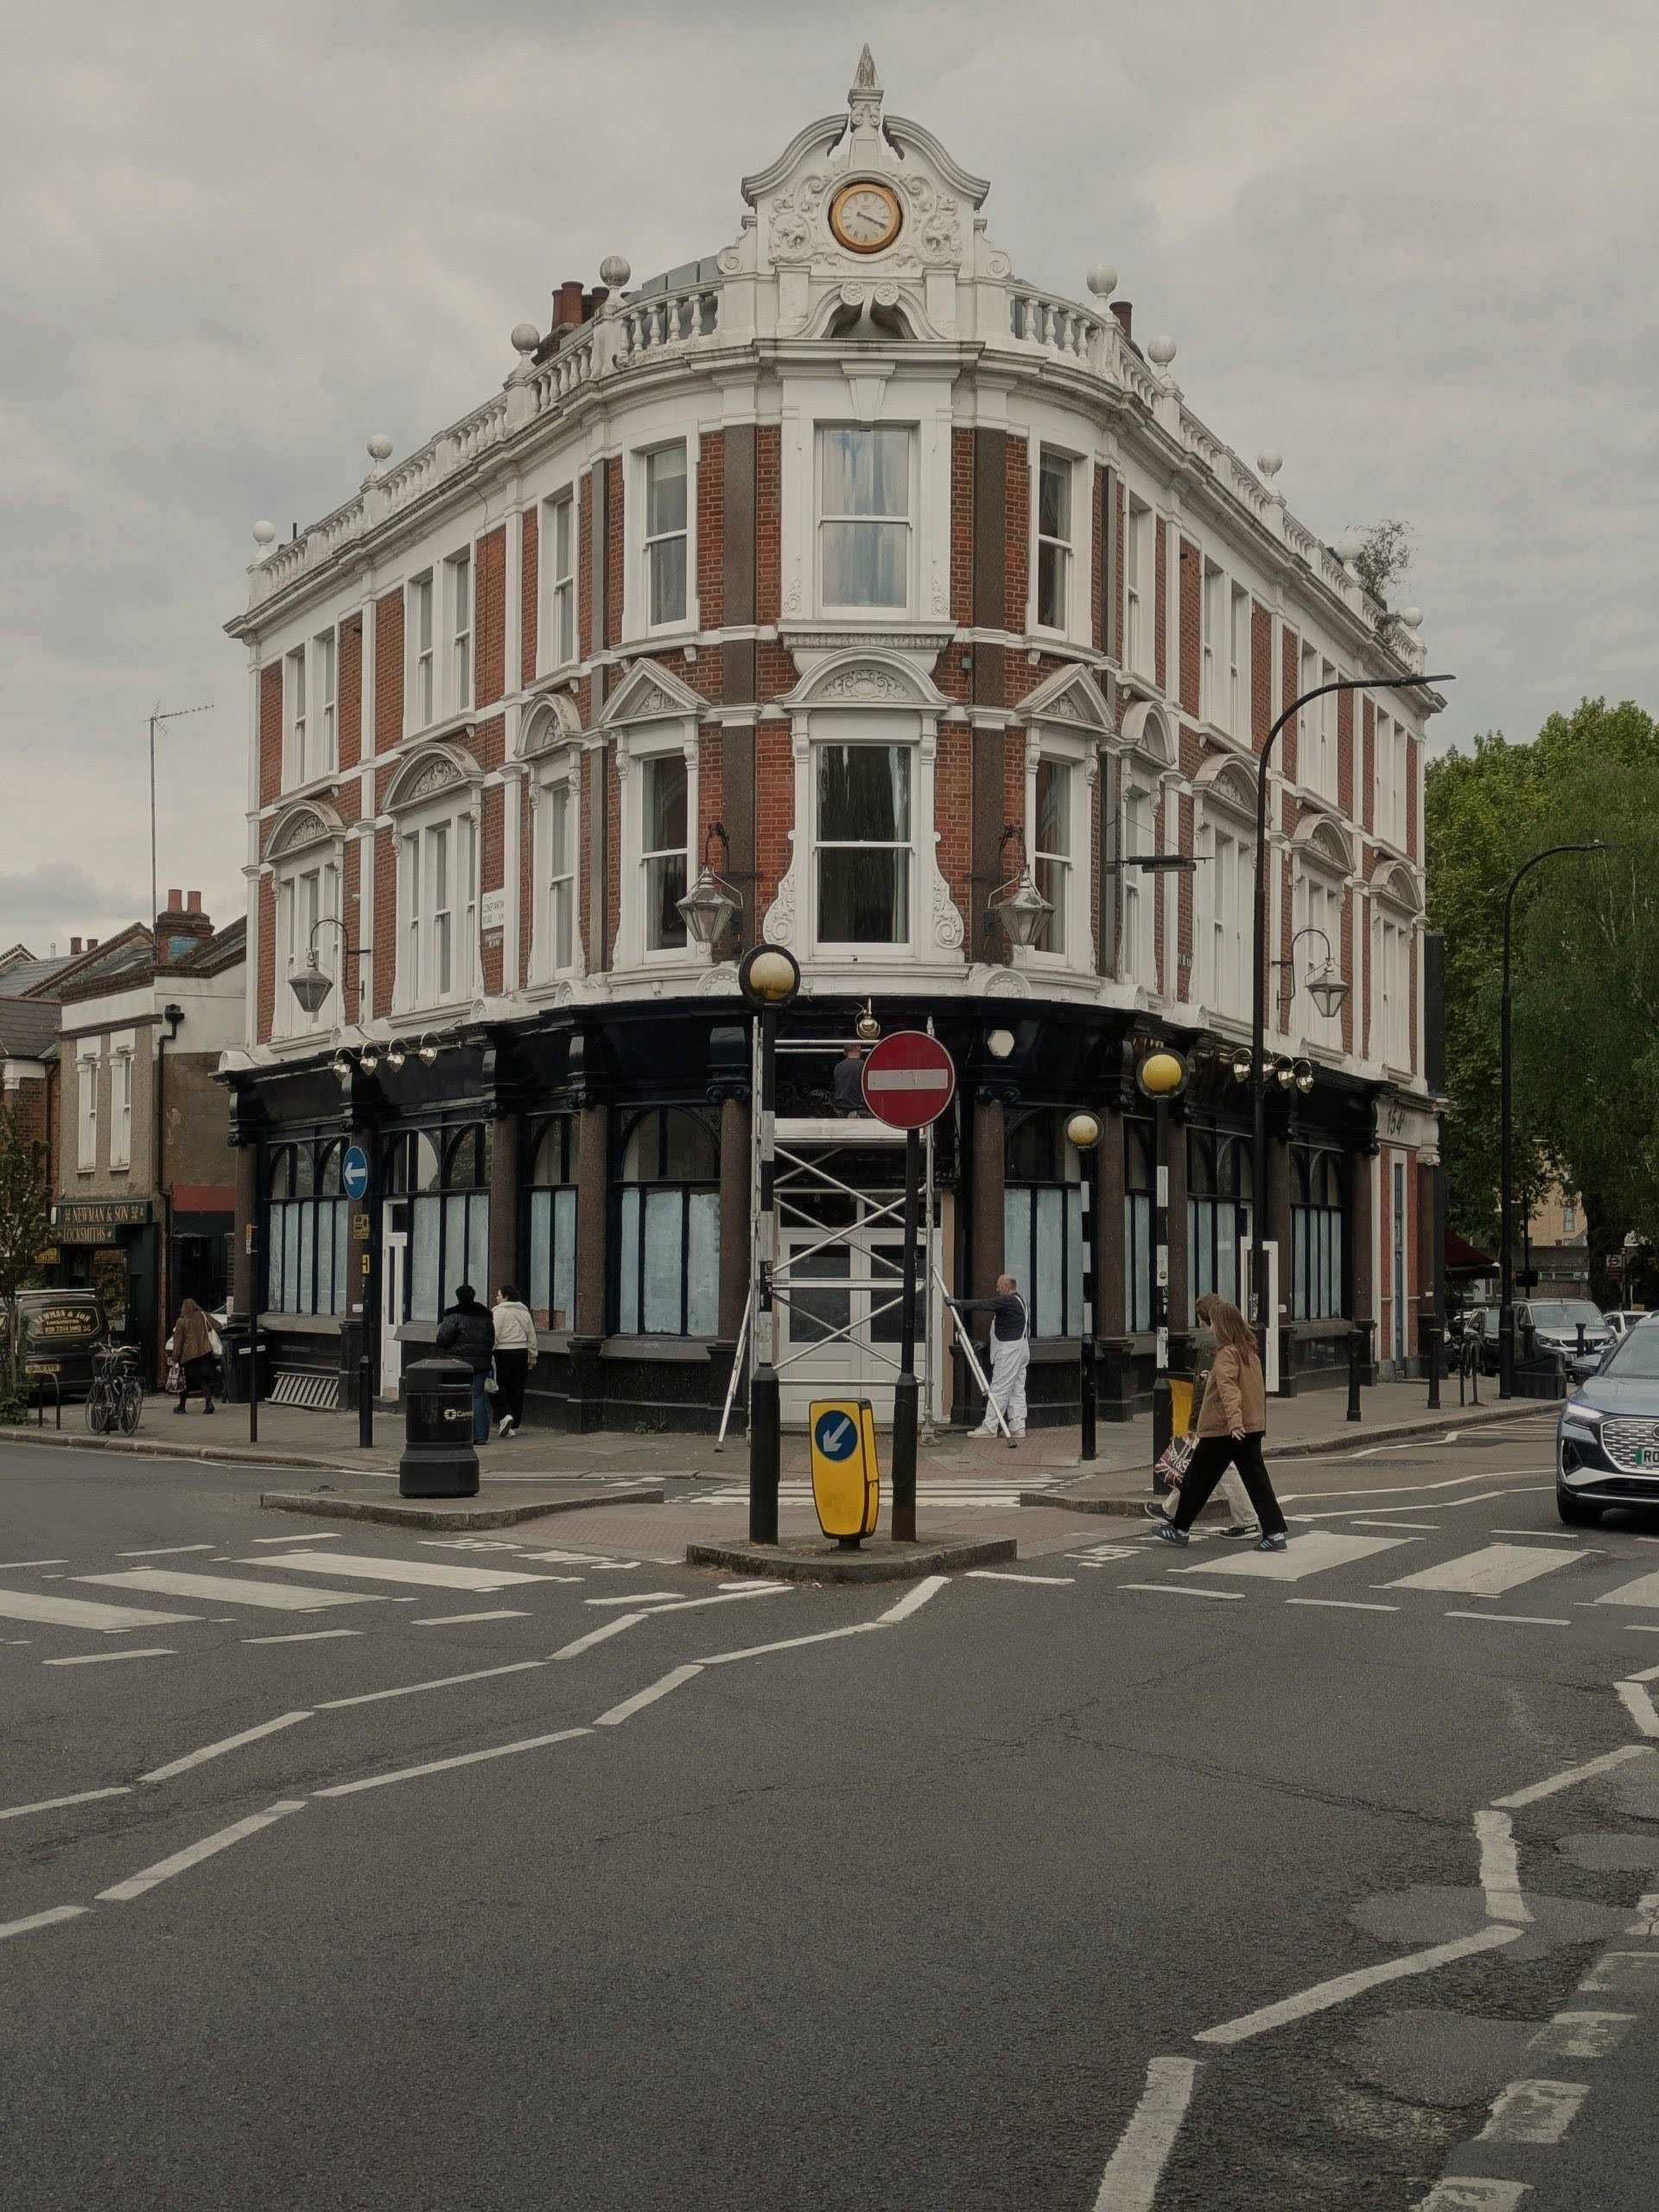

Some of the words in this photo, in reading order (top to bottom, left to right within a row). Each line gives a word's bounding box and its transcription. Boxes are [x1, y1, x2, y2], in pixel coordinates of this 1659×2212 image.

[73, 1206, 105, 1224] NEWMAN
[106, 1207, 112, 1223] &
[114, 1205, 130, 1222] SON
[63, 1227, 105, 1243] LOCKSMITHS
[35, 1310, 66, 1324] NEWMAN
[76, 1312, 92, 1322] SON
